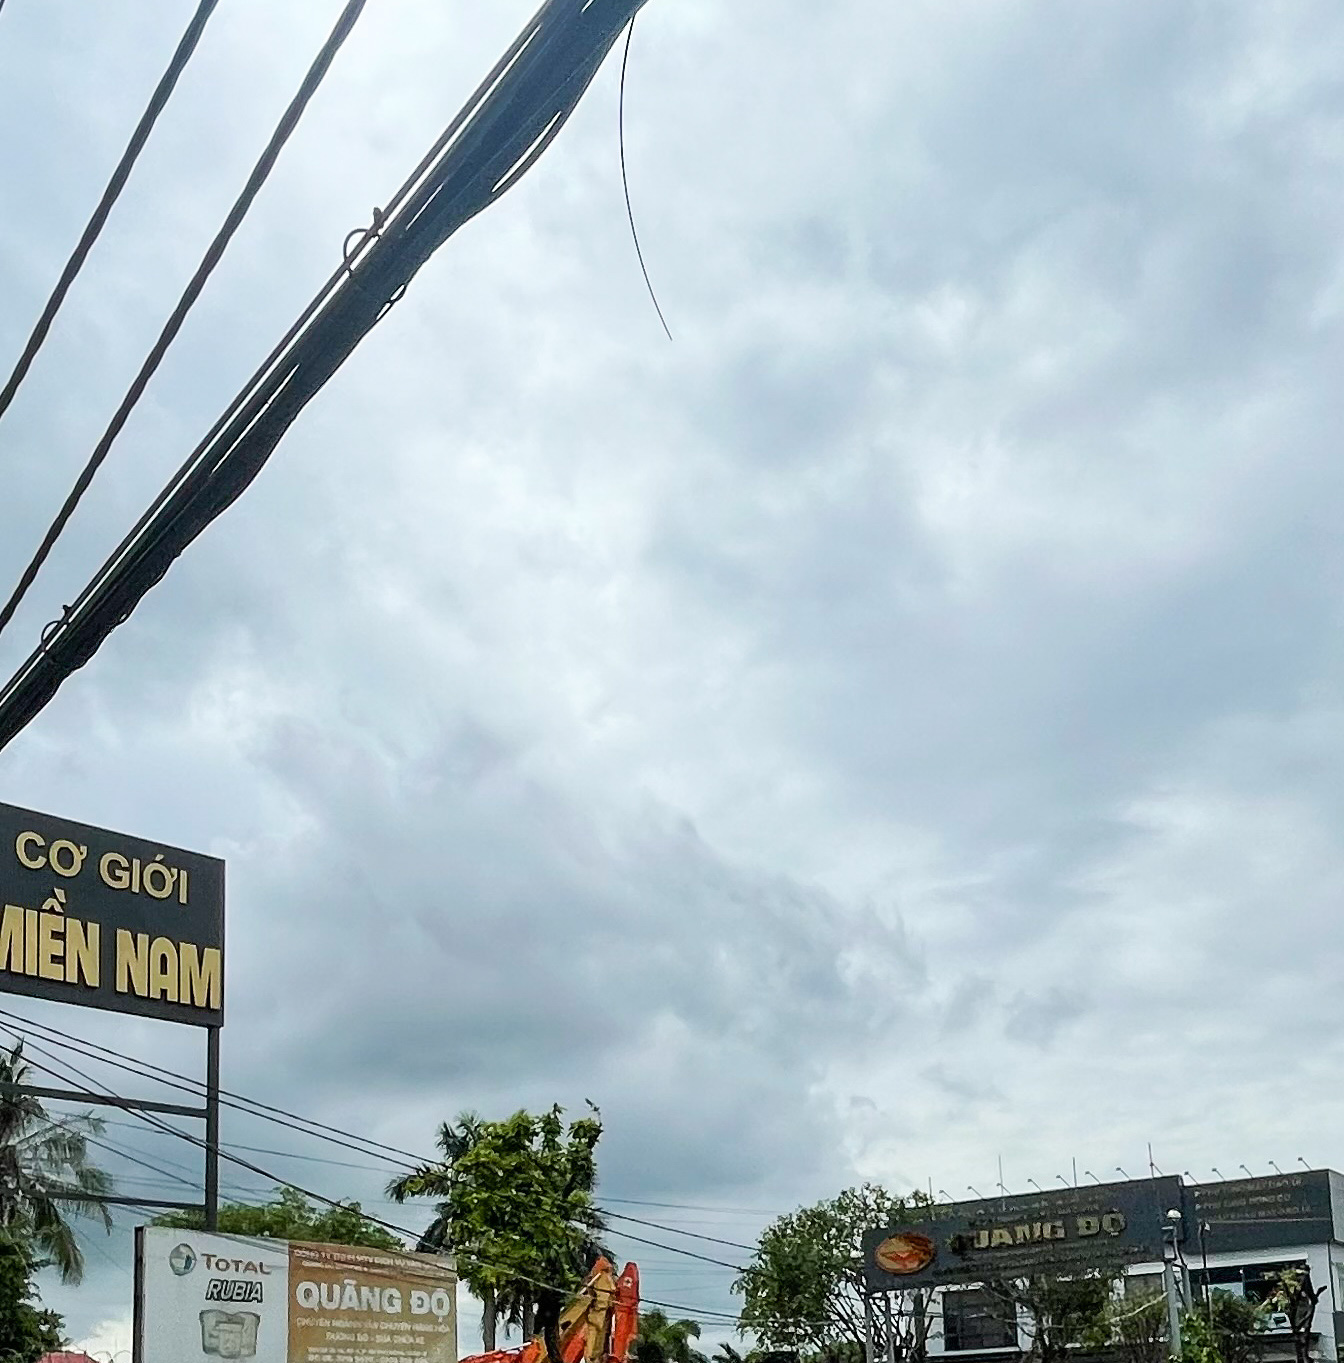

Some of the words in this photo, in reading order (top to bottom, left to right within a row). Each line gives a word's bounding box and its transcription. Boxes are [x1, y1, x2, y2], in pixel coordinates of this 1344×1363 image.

[15, 830, 88, 878] CƠ
[99, 854, 189, 904] GIỚI
[115, 928, 222, 1010] NAM
[201, 1253, 272, 1275] TOTAL
[205, 1278, 264, 1303] RUBIA
